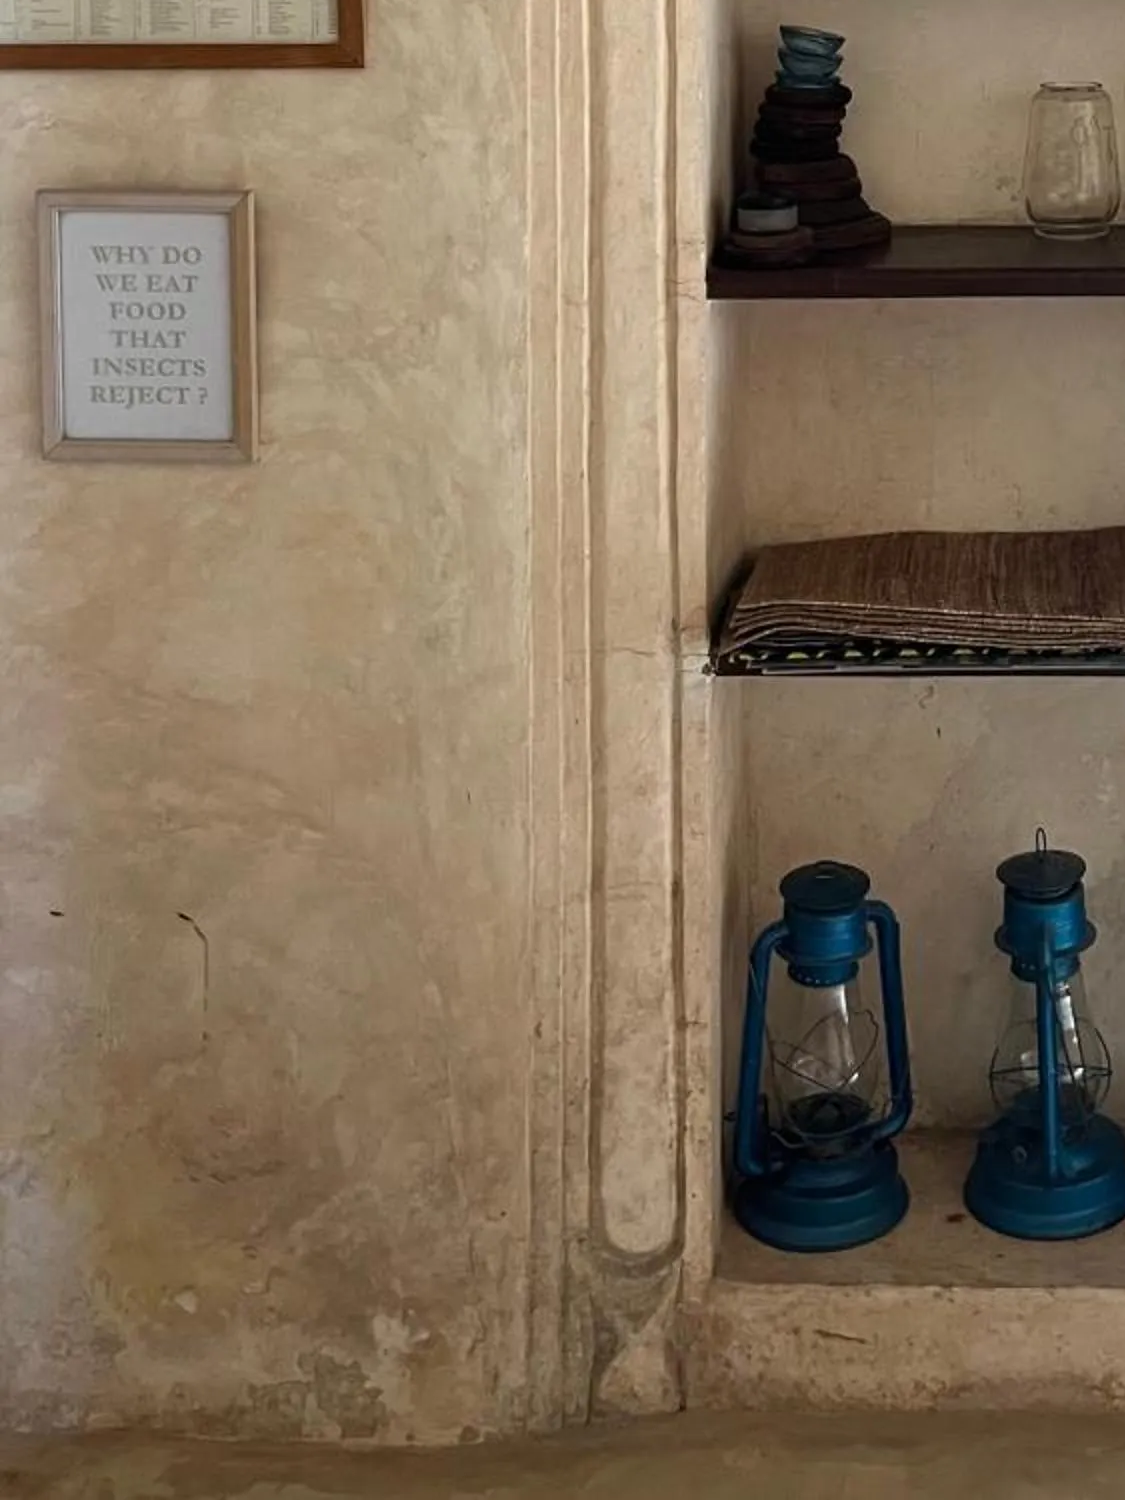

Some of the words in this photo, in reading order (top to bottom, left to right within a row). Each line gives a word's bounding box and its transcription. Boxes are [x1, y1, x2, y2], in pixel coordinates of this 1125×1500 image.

[90, 245, 153, 265] WHY
[161, 245, 202, 265] DO
[94, 274, 138, 293] WE
[146, 274, 199, 293] EAT
[109, 302, 187, 321] FOOD
[109, 330, 187, 349] THAT
[91, 357, 207, 377] INSECTS
